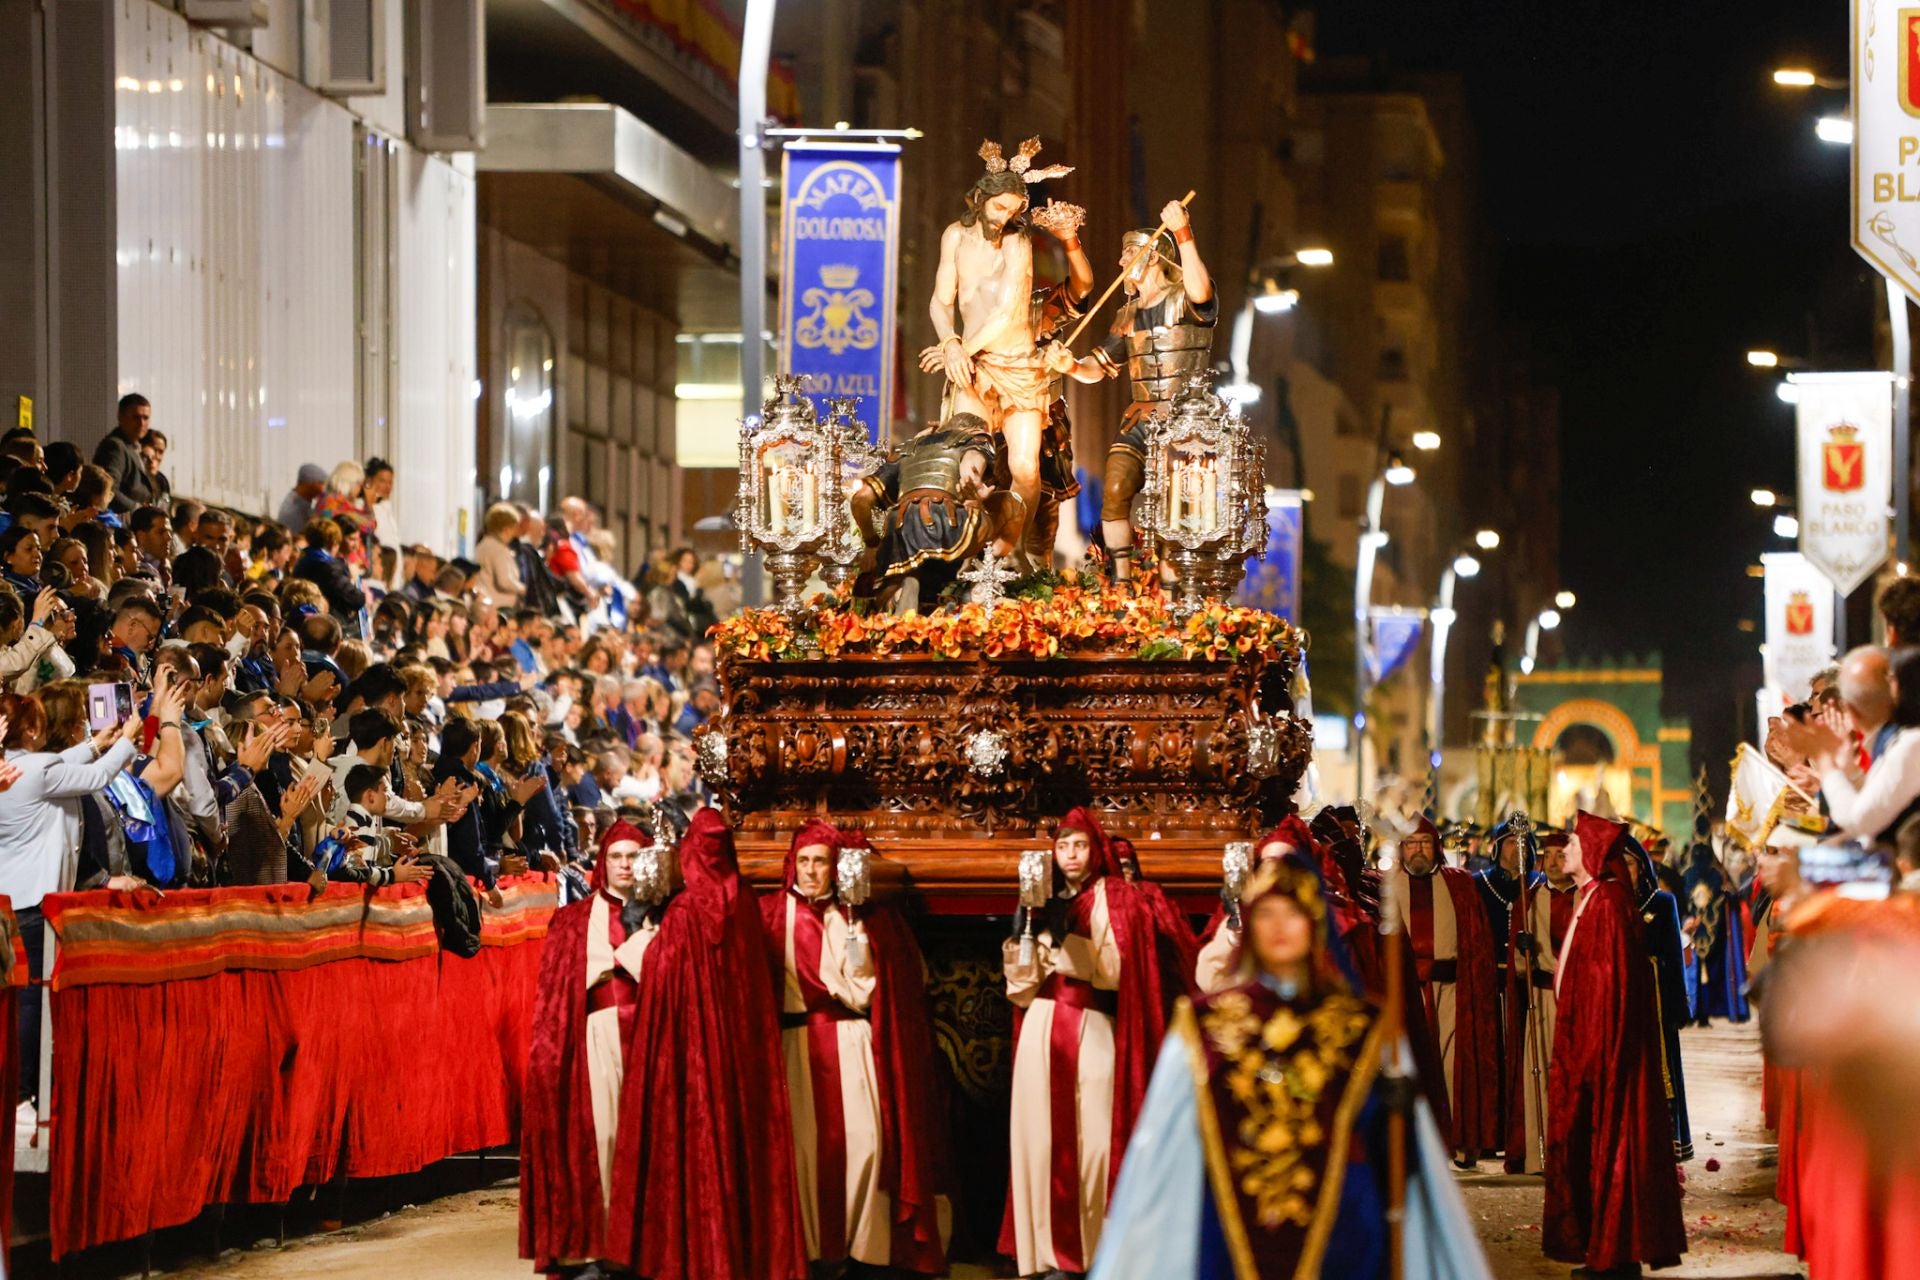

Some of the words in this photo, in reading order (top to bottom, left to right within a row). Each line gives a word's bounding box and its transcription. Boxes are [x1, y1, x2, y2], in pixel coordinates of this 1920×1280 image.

[1899, 136, 1920, 166] P
[807, 173, 877, 211] MATER
[1873, 172, 1920, 203] BL
[797, 217, 885, 240] DOLOROSA
[798, 373, 833, 394] ASO
[834, 373, 878, 397] AZUL
[1821, 503, 1865, 517] PASO
[1808, 521, 1880, 537] BLANCO
